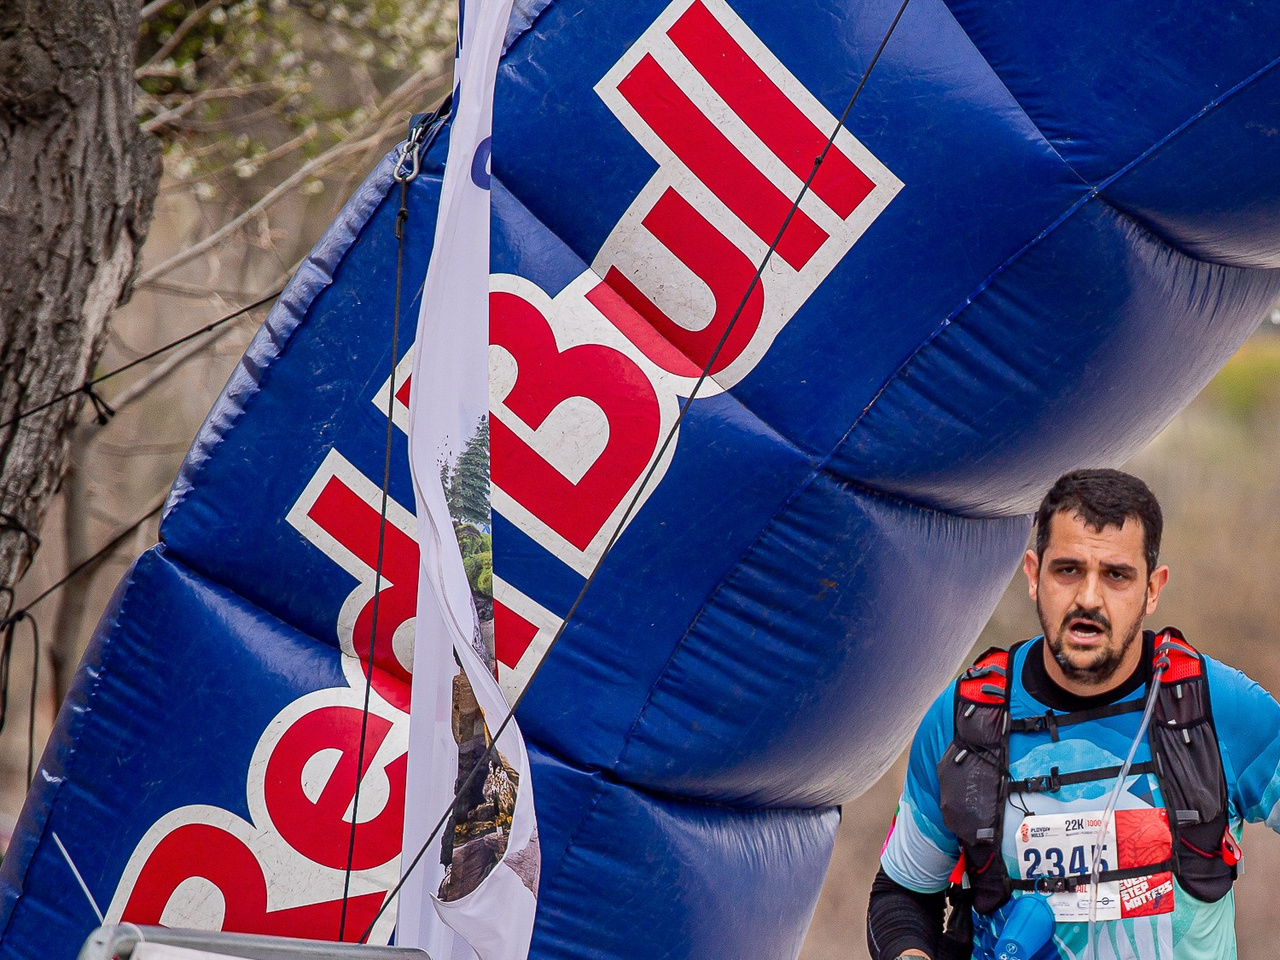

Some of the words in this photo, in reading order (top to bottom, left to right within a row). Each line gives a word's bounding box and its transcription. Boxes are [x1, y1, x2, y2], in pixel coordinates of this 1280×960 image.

[121, 474, 541, 942] Red
[396, 0, 875, 553] Bull
[1065, 819, 1084, 831] 22K
[1120, 882, 1149, 900] STEP
[1123, 880, 1173, 911] MATTERS
